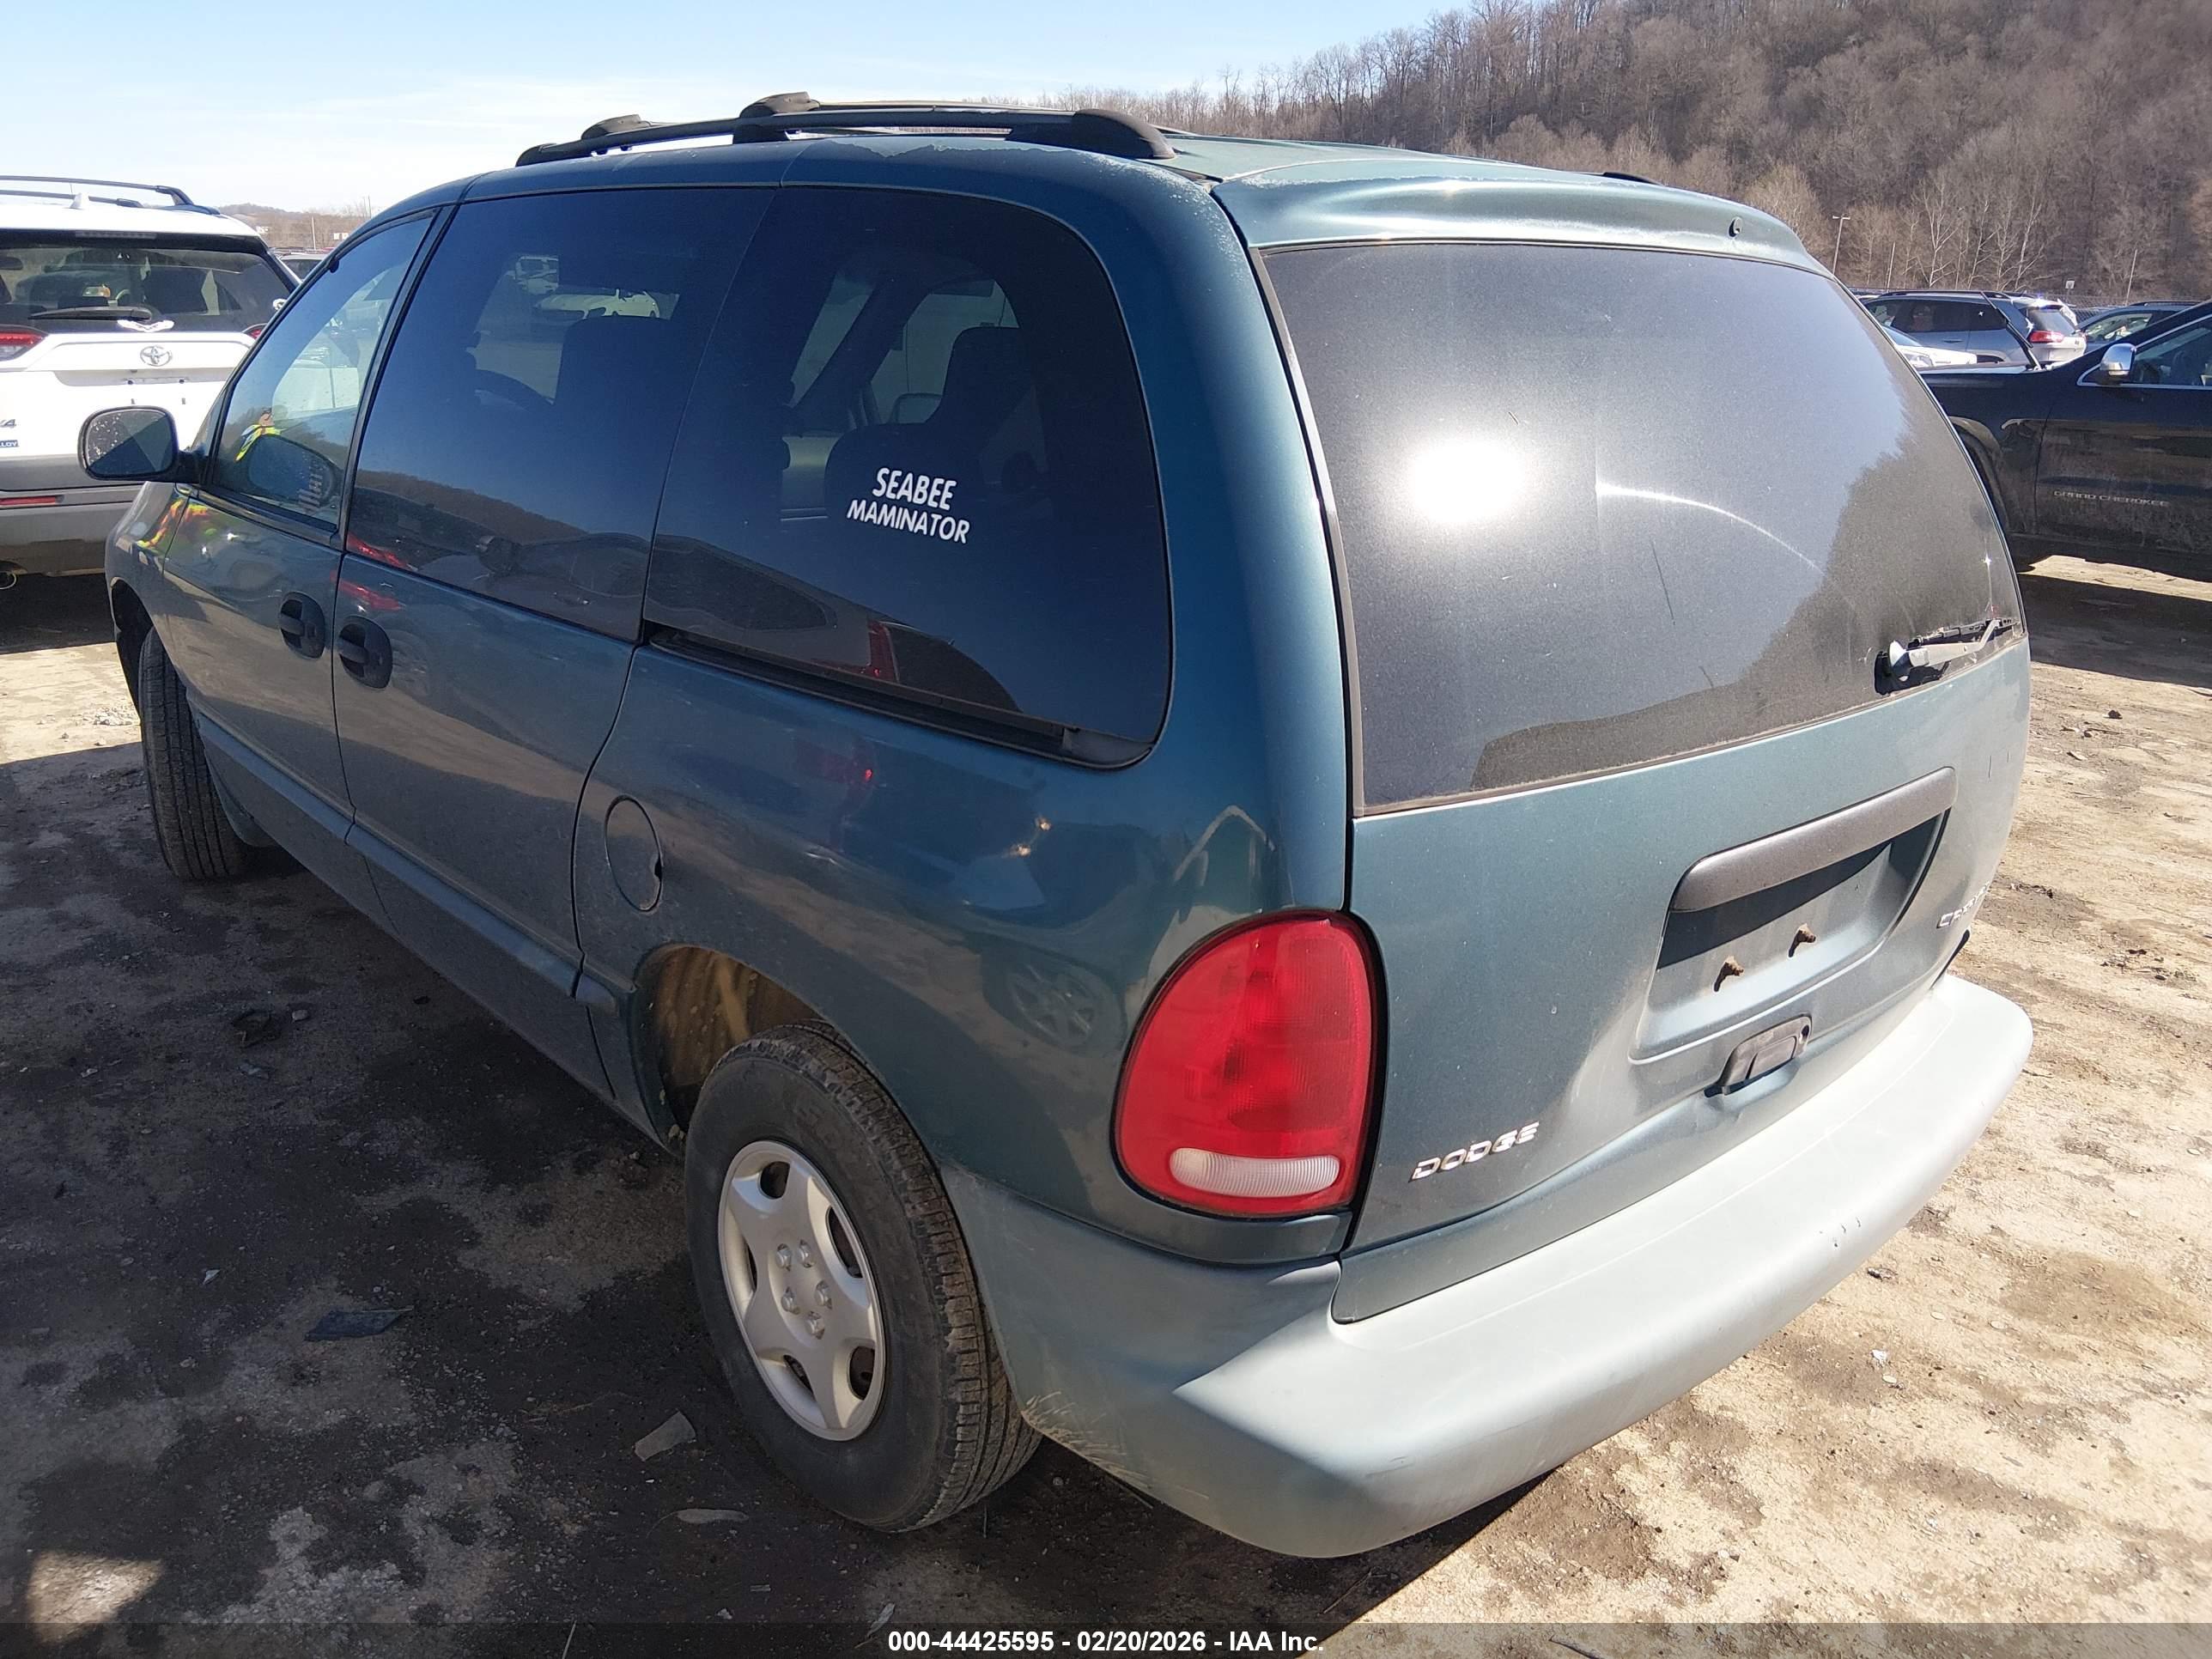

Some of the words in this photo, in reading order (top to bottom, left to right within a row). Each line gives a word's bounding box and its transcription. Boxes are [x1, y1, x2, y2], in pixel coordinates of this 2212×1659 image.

[872, 467, 957, 511] SEABEE
[847, 499, 970, 544] MAMINATOR
[1409, 1121, 1540, 1181] DODGE
